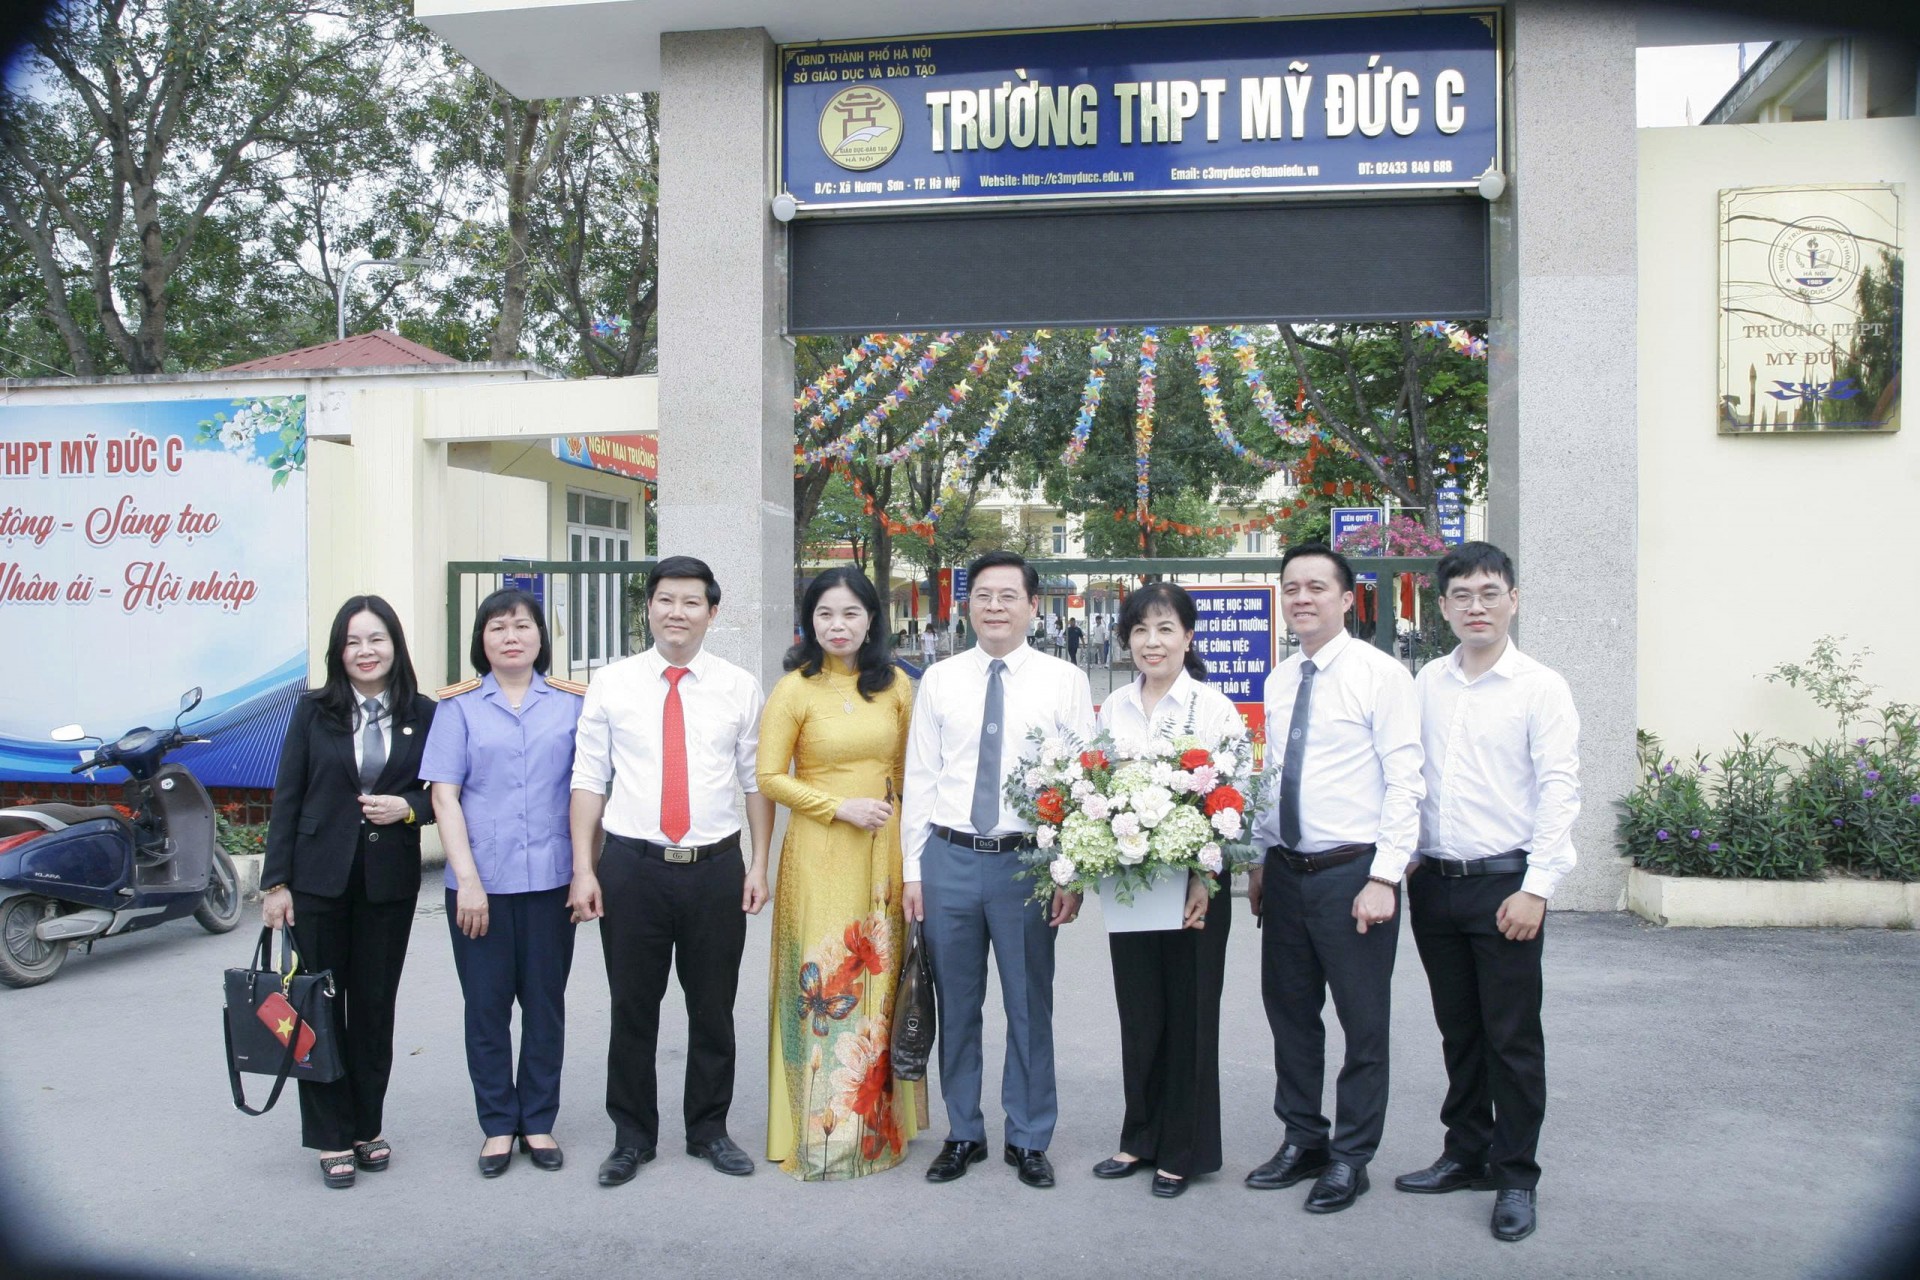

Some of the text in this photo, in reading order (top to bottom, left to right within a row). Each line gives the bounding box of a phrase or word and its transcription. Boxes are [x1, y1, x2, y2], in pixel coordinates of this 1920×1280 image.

[796, 45, 932, 66] UBND THÀNH PHỐ HÀ NỘI
[793, 63, 936, 84] SỞ GIÁO DỤC VÀ ĐÀO TẠO
[926, 55, 1465, 152] TRƯỜNG THPT MỸ ĐỨC C
[859, 155, 873, 163] NỘI
[1376, 161, 1407, 175] 02433
[1411, 161, 1430, 173] 849
[1433, 160, 1453, 173] 688
[979, 174, 1020, 187] Website:
[1171, 167, 1200, 180] Email:
[839, 181, 851, 193] Xã
[854, 181, 883, 194] Hương
[887, 179, 904, 192] Sơn
[929, 176, 941, 189] Hà
[944, 176, 960, 191] Nội
[1833, 323, 1883, 337] THPT
[1766, 349, 1797, 366] MỸ
[60, 434, 98, 475] MỸ
[107, 432, 157, 474] ĐỨC
[167, 437, 182, 473] C
[588, 436, 656, 470] NGÀY MAI TRƯỜNG
[85, 495, 170, 545] Sáng
[176, 503, 220, 543] tạo
[1343, 524, 1361, 532] KHÔN
[66, 574, 94, 602] ái
[123, 561, 183, 611] Hội
[187, 570, 258, 611] nhập
[1196, 598, 1262, 613] CHA MẸ HỌC SINH
[1209, 617, 1220, 632] CŨ
[1221, 615, 1237, 632] ĐẾN
[1238, 616, 1269, 632] TRƯỜNG
[1199, 638, 1209, 655] HỆ
[1210, 638, 1231, 653] CÔNG
[1232, 637, 1250, 655] VIỆC
[1232, 656, 1246, 673] TẮT
[1247, 658, 1265, 673] MÁY
[1224, 677, 1240, 694] BẢO
[1240, 678, 1250, 696] VỆ
